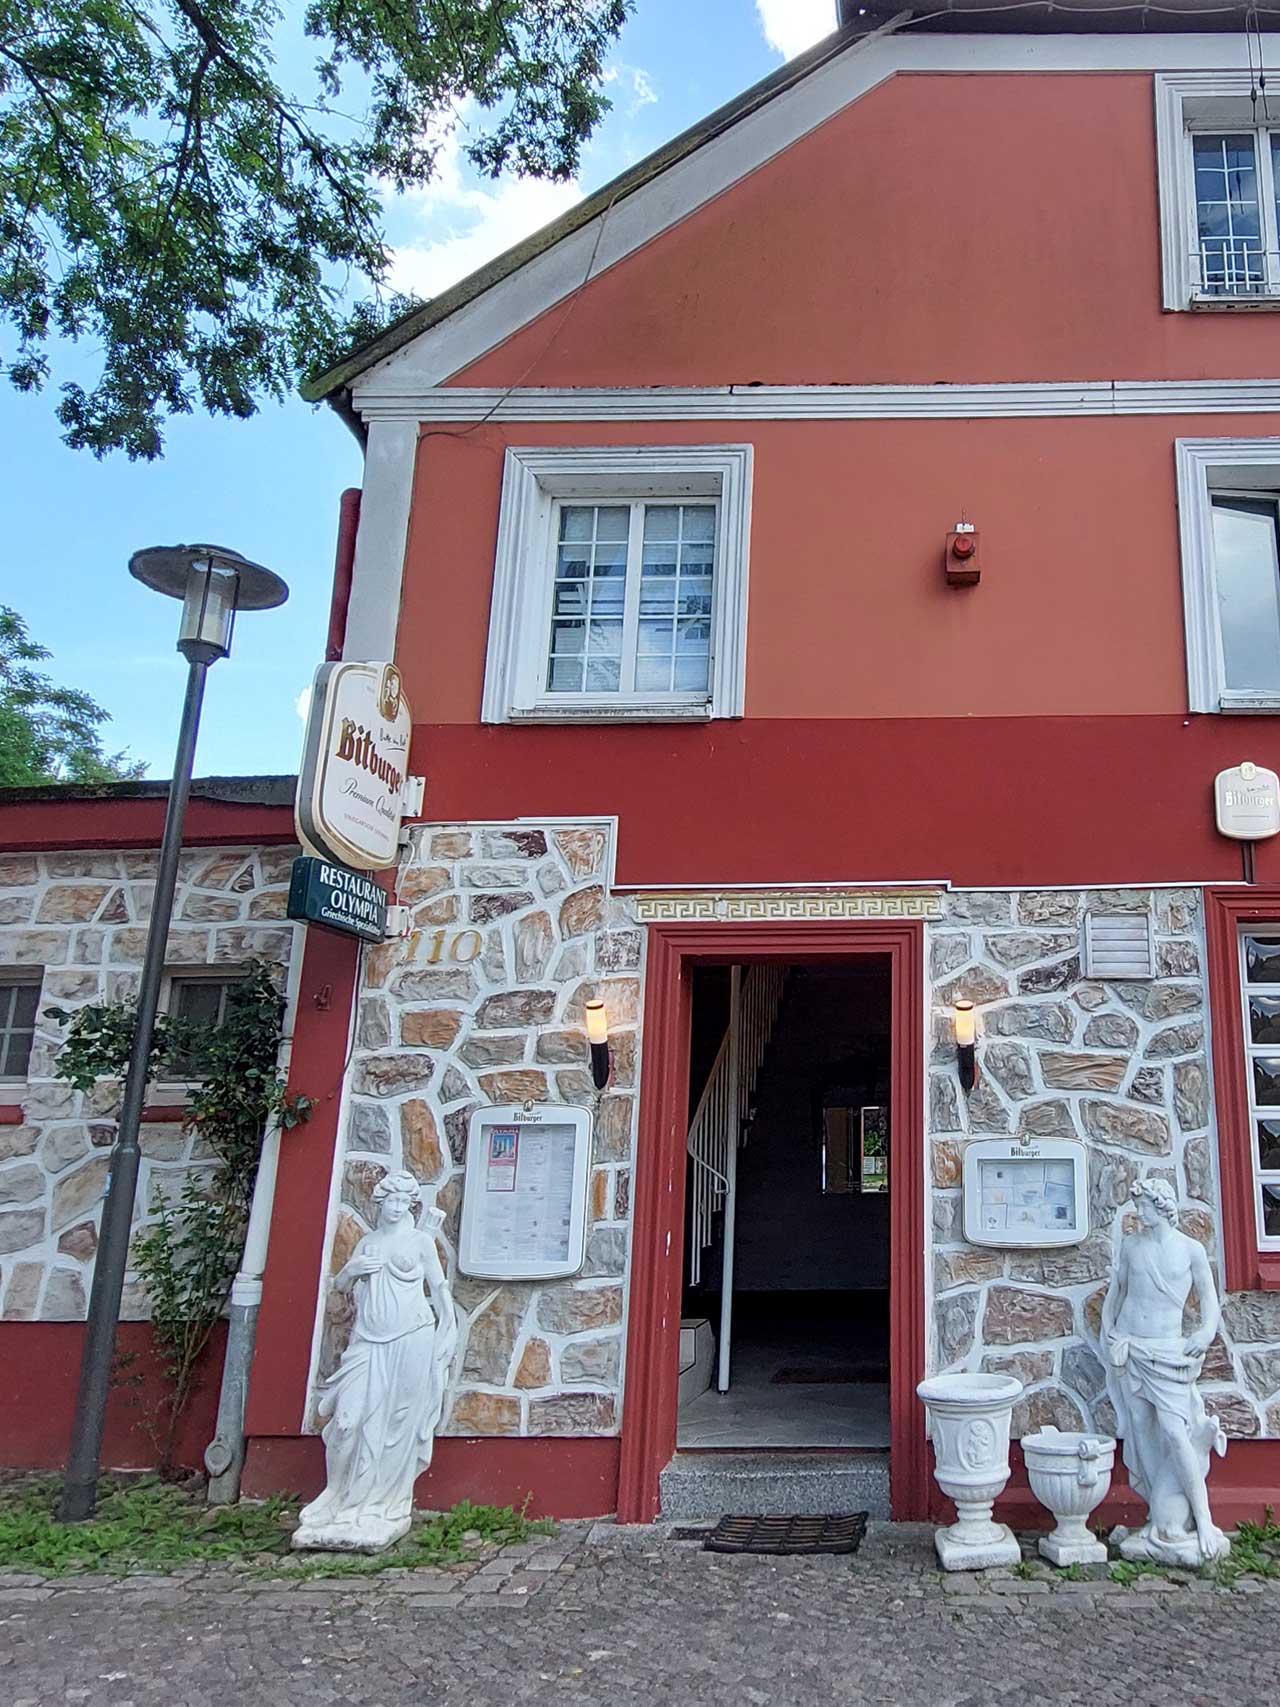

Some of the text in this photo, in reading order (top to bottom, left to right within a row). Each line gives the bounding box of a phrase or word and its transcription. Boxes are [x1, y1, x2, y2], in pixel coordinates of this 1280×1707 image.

[319, 864, 388, 908] RESTAURANT
[321, 906, 355, 925] Griechische
[330, 889, 378, 924] OLYMPIA
[405, 929, 483, 964] 110
